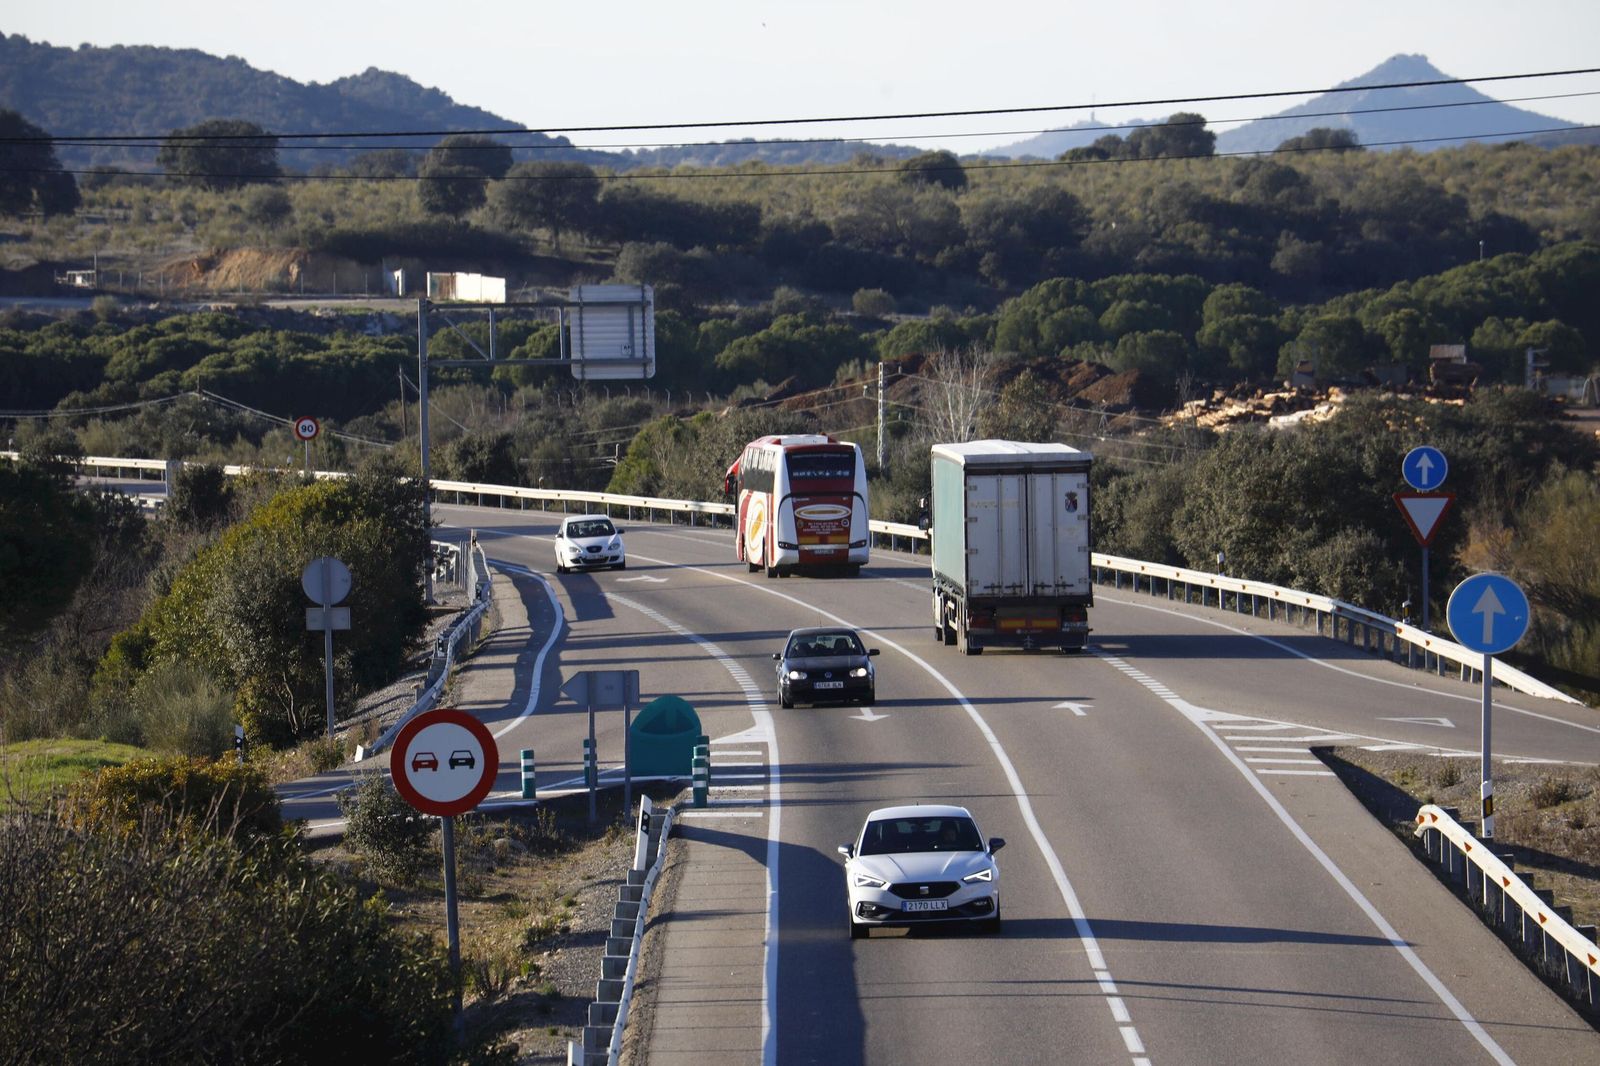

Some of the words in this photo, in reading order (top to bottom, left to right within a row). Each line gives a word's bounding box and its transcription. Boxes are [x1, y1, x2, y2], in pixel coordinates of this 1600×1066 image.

[301, 424, 313, 433] 90
[908, 902, 928, 910] 2170
[930, 901, 946, 909] LLX
